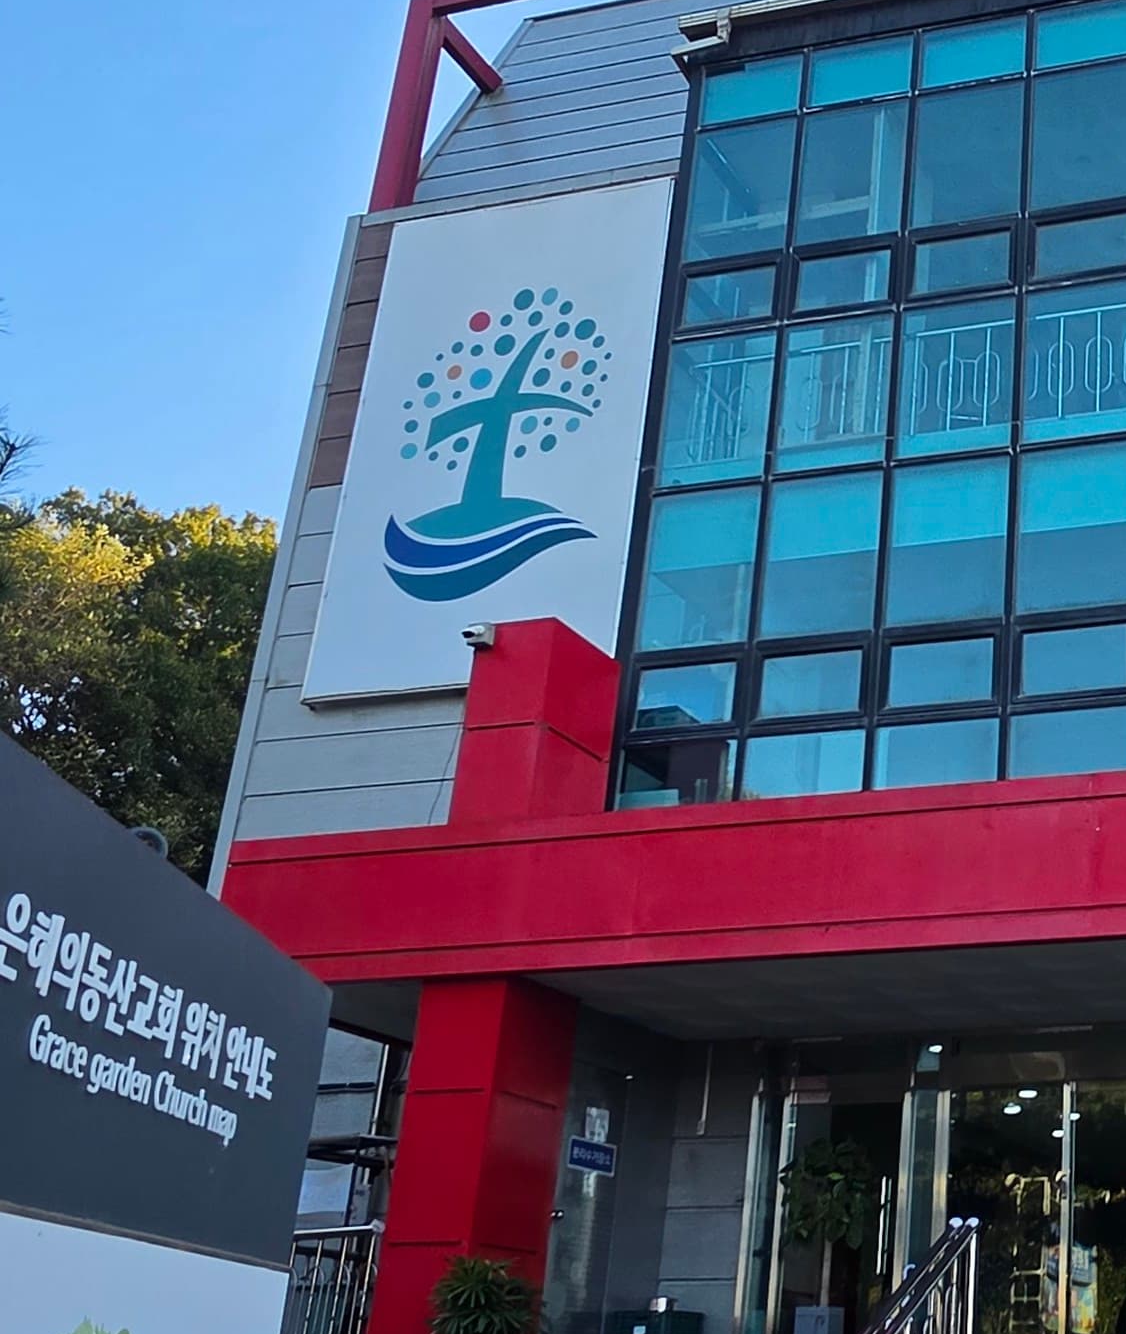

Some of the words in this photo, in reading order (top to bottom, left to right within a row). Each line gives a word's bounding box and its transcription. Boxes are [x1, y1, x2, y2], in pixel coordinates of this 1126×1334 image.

[0, 893, 184, 1059] 은혜의동산교회
[181, 1002, 227, 1079] 위치
[222, 1026, 278, 1101] 안내도
[29, 1014, 88, 1078] Grace
[86, 1053, 152, 1105] garden
[154, 1070, 209, 1128] Church
[207, 1104, 238, 1148] map
